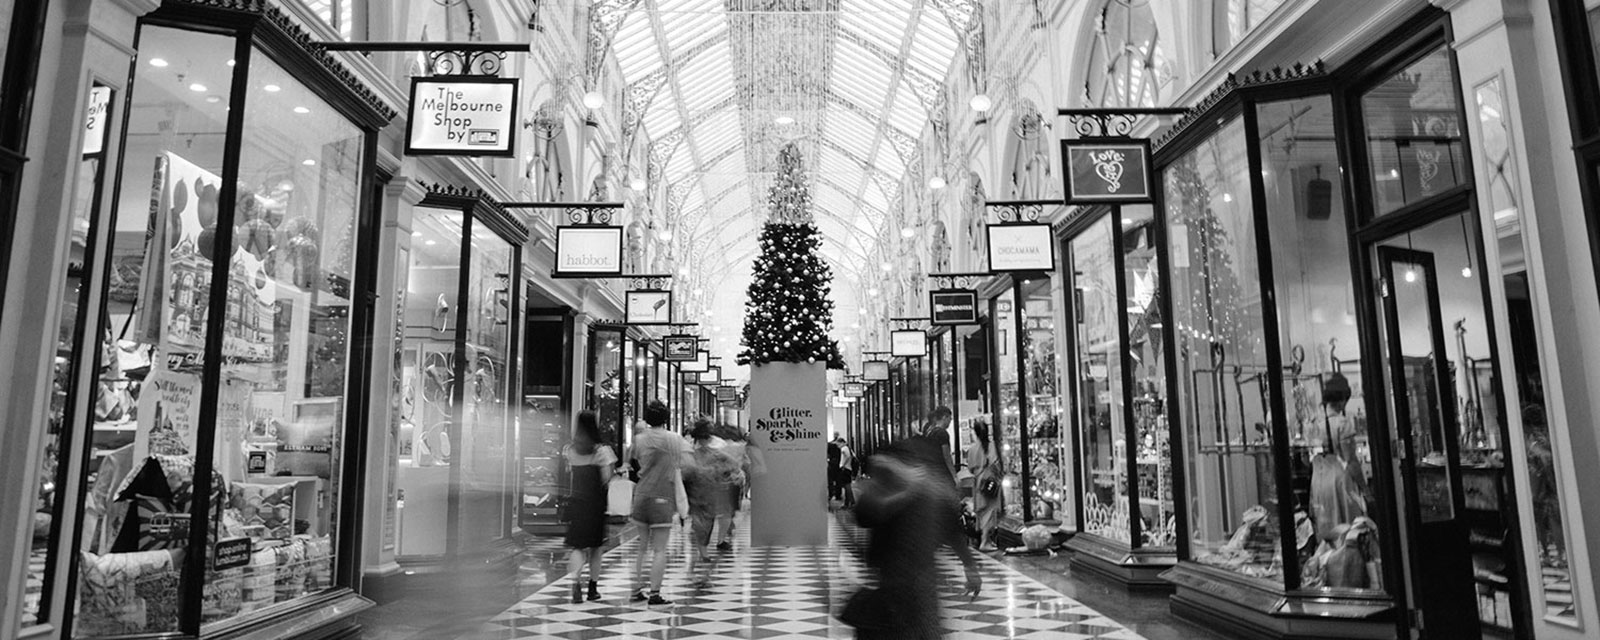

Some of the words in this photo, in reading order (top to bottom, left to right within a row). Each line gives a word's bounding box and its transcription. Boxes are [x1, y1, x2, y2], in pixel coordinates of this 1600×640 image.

[438, 87, 463, 100] The
[421, 97, 503, 112] Melbourne
[434, 112, 472, 130] Shop
[447, 130, 465, 143] by
[769, 407, 813, 420] Glitter.
[756, 418, 804, 431] Sparkle
